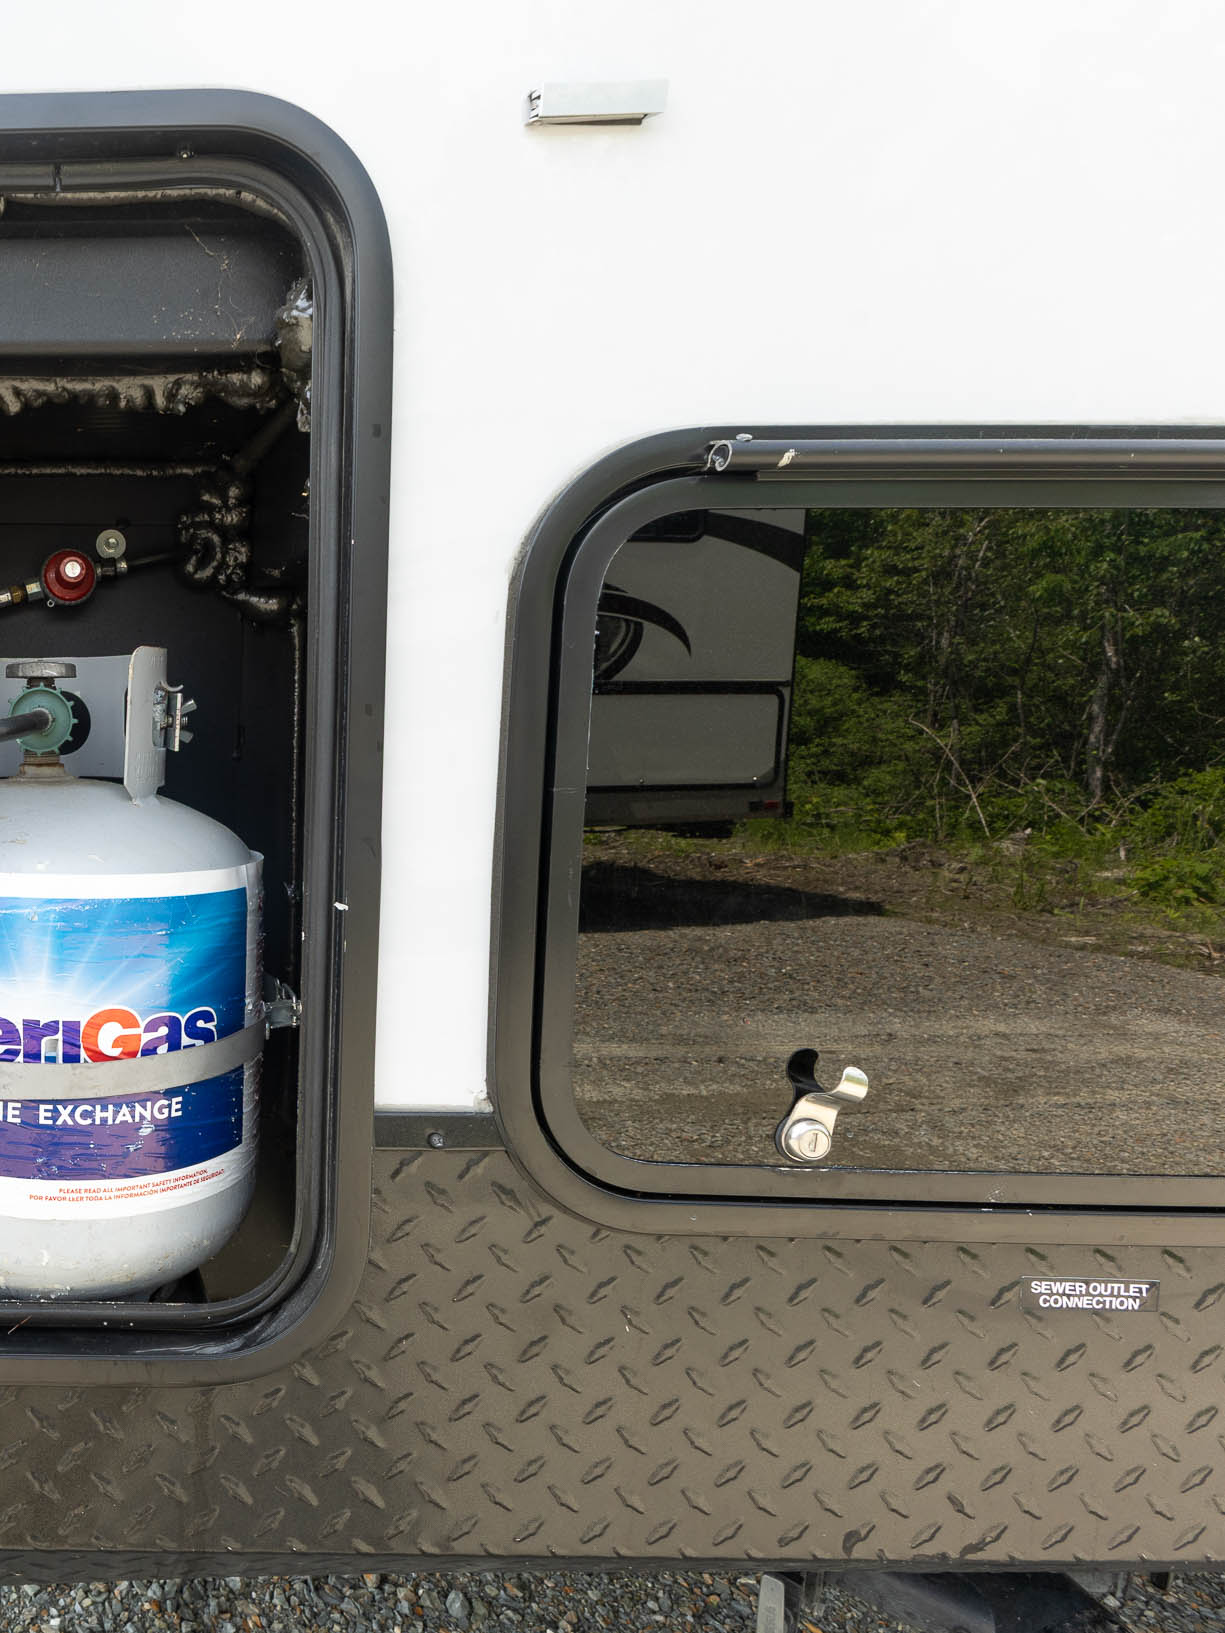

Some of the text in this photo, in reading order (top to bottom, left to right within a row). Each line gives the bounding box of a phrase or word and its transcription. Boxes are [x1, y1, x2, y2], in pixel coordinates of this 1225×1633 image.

[39, 1097, 183, 1125] EXCHANGE
[114, 1182, 151, 1192] IMPORTANT
[152, 1178, 172, 1188] SAFETY
[159, 1180, 193, 1193] IMPORTANTE
[1031, 1281, 1149, 1296] SEWER OUTLET
[1039, 1295, 1140, 1310] CONNECTION
